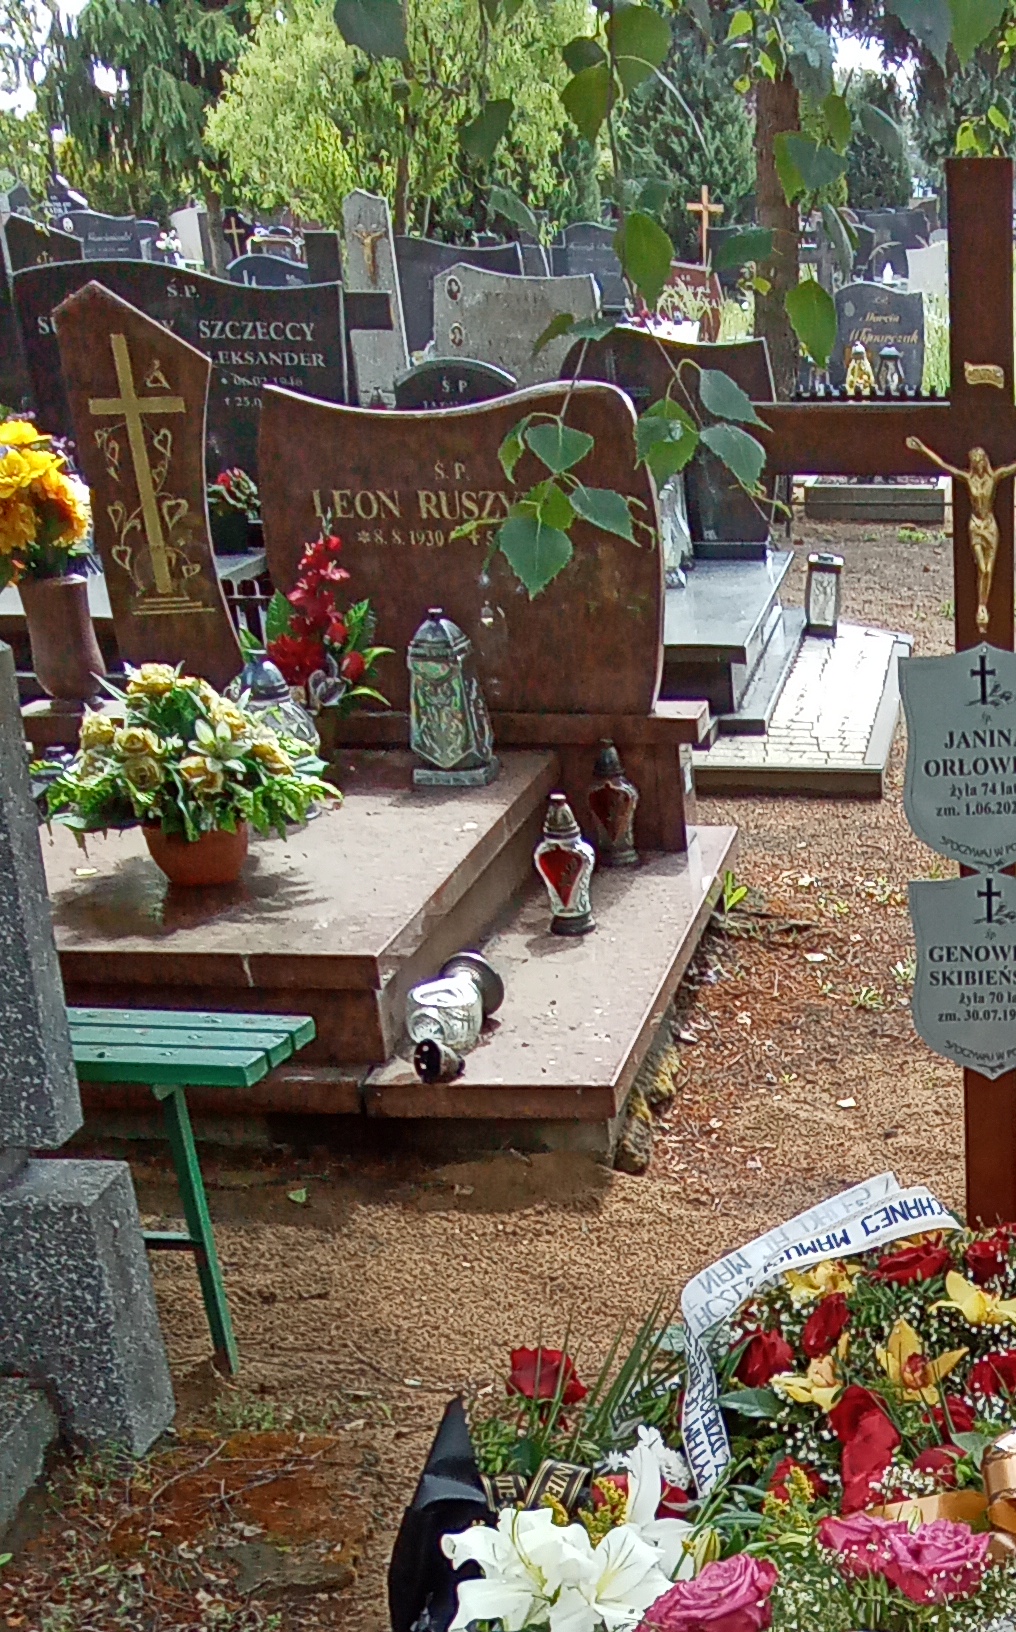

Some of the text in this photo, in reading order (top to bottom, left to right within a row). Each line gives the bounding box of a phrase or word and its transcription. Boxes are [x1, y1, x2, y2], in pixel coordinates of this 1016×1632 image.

[199, 319, 315, 342] SZCZECCY
[211, 351, 327, 368] LEKSANDER
[312, 488, 403, 520] LEON
[981, 782, 997, 797] 74
[935, 806, 961, 818] zm.
[940, 834, 993, 858] SPOCZYWAJ
[994, 846, 1005, 858] W
[989, 991, 1004, 1004] 70
[937, 1012, 962, 1023] zm.
[943, 1039, 995, 1062] SPOCZYWAJ
[995, 1050, 1006, 1061] W
